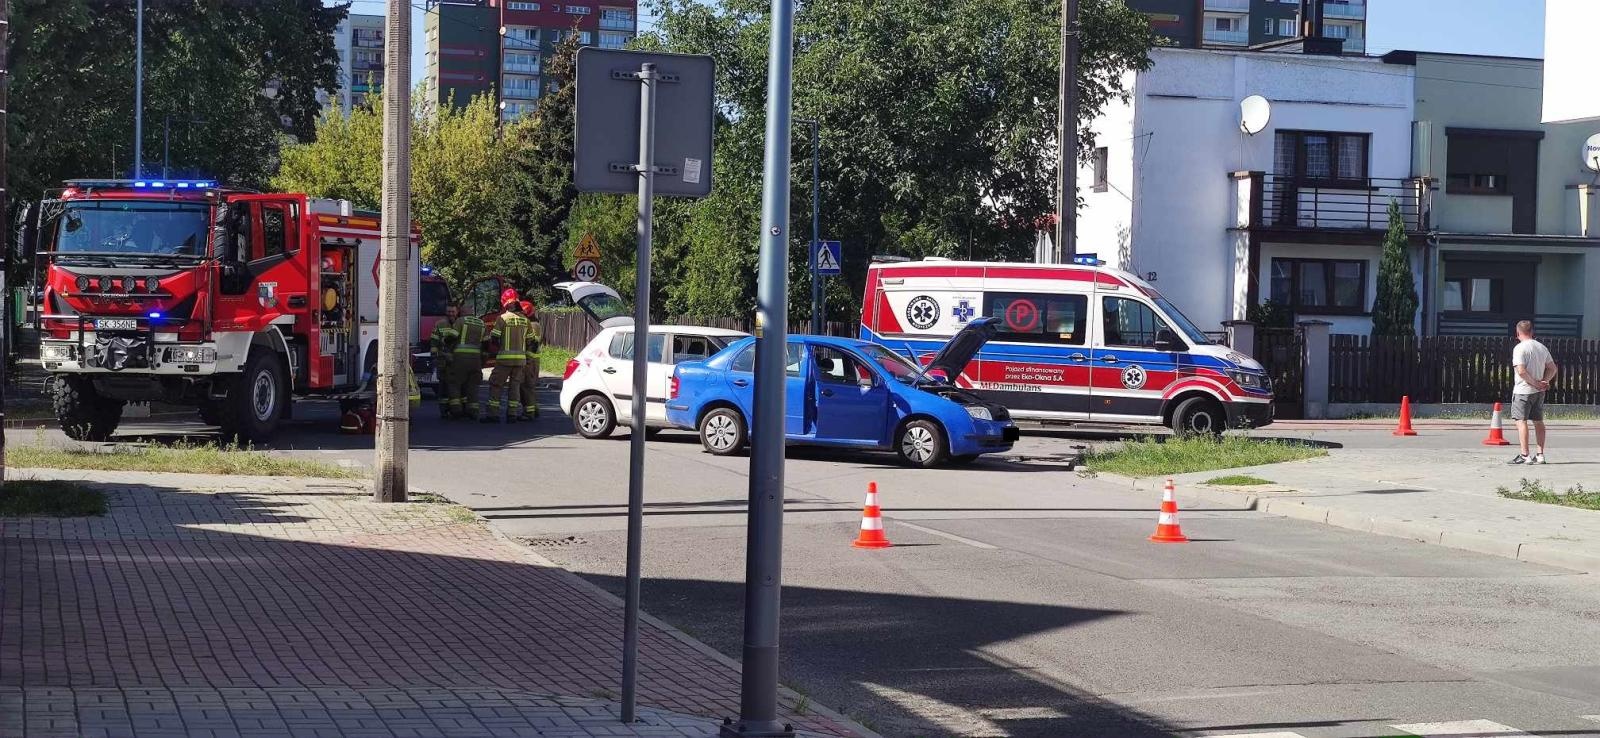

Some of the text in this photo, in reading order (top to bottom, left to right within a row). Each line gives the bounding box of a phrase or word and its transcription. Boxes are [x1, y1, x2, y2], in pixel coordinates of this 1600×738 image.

[578, 265, 595, 278] 40
[1147, 271, 1157, 281] 12
[99, 320, 135, 329] SK 356NE
[1005, 365, 1064, 375] Pojazd sfinansowany
